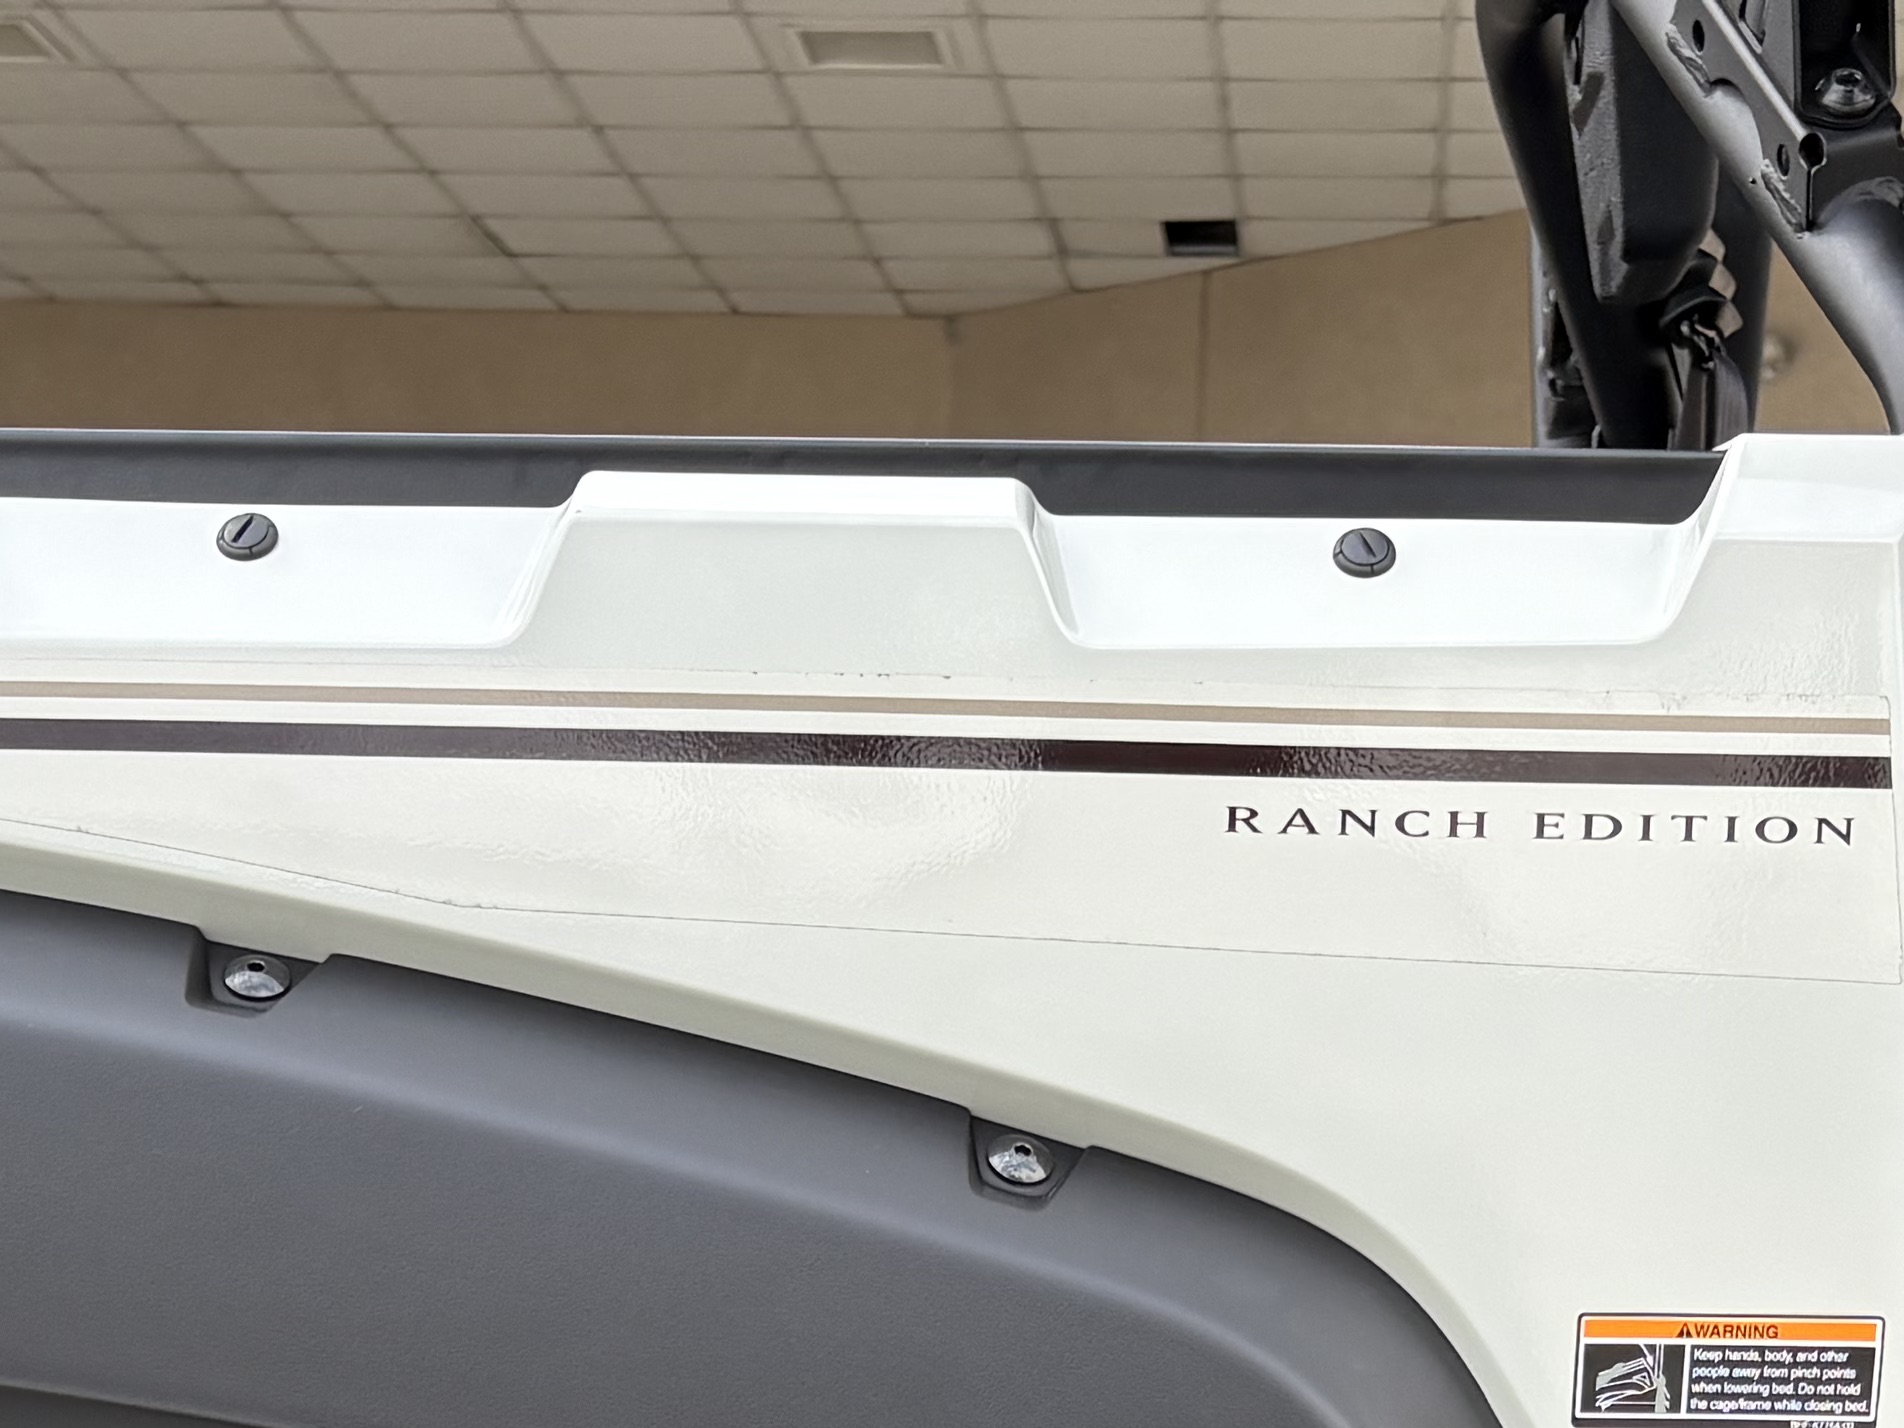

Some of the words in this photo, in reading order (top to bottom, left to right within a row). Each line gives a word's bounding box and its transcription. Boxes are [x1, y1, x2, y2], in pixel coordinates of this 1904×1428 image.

[1224, 805, 1489, 841] RANCH
[1532, 811, 1855, 847] EDITION
[1693, 1322, 1779, 1340] WARNING
[1694, 1348, 1722, 1363] Keep
[1764, 1349, 1793, 1364] body,
[1796, 1350, 1818, 1362] and
[1820, 1351, 1849, 1362] other
[1692, 1365, 1730, 1379] people
[1732, 1368, 1762, 1380] away
[1763, 1366, 1787, 1378] from
[1790, 1366, 1820, 1380] pinch
[1822, 1367, 1856, 1381] points
[1691, 1381, 1721, 1393] when
[1723, 1382, 1769, 1397] lowering
[1772, 1383, 1795, 1395] bed.
[1798, 1383, 1814, 1395] Do
[1816, 1384, 1835, 1395] not
[1836, 1384, 1861, 1395] hold
[1690, 1398, 1708, 1409] the
[1774, 1399, 1802, 1410] while
[1804, 1399, 1843, 1414] closing
[1845, 1400, 1868, 1412] bed.
